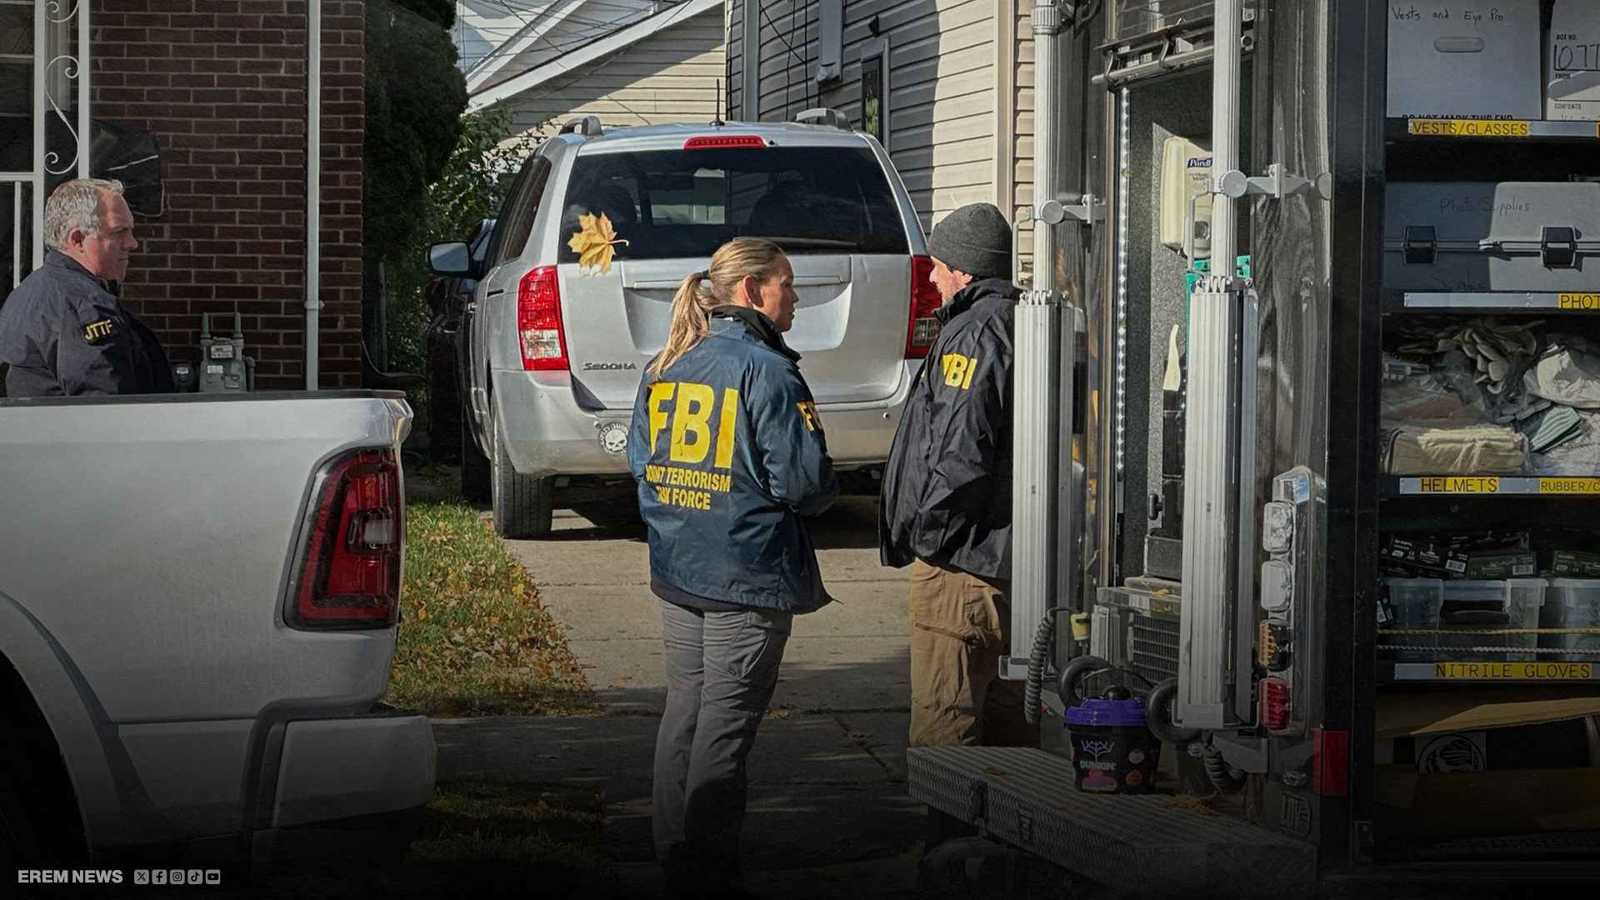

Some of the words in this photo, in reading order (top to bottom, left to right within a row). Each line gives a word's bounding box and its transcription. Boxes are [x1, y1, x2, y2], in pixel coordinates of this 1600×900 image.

[1391, 6, 1421, 20] Vests
[1431, 9, 1449, 19] and
[1463, 10, 1481, 24] Eye
[1489, 9, 1504, 20] Pro
[1413, 122, 1529, 135] VESTS/GLASSES
[85, 319, 113, 340] JTTF
[648, 382, 739, 469] FBI
[666, 467, 732, 493] TERRORISM
[1420, 479, 1499, 492] HELMETS
[672, 488, 712, 511] FORCE
[1435, 665, 1513, 678] NITRILE
[1524, 664, 1591, 679] GLOVES
